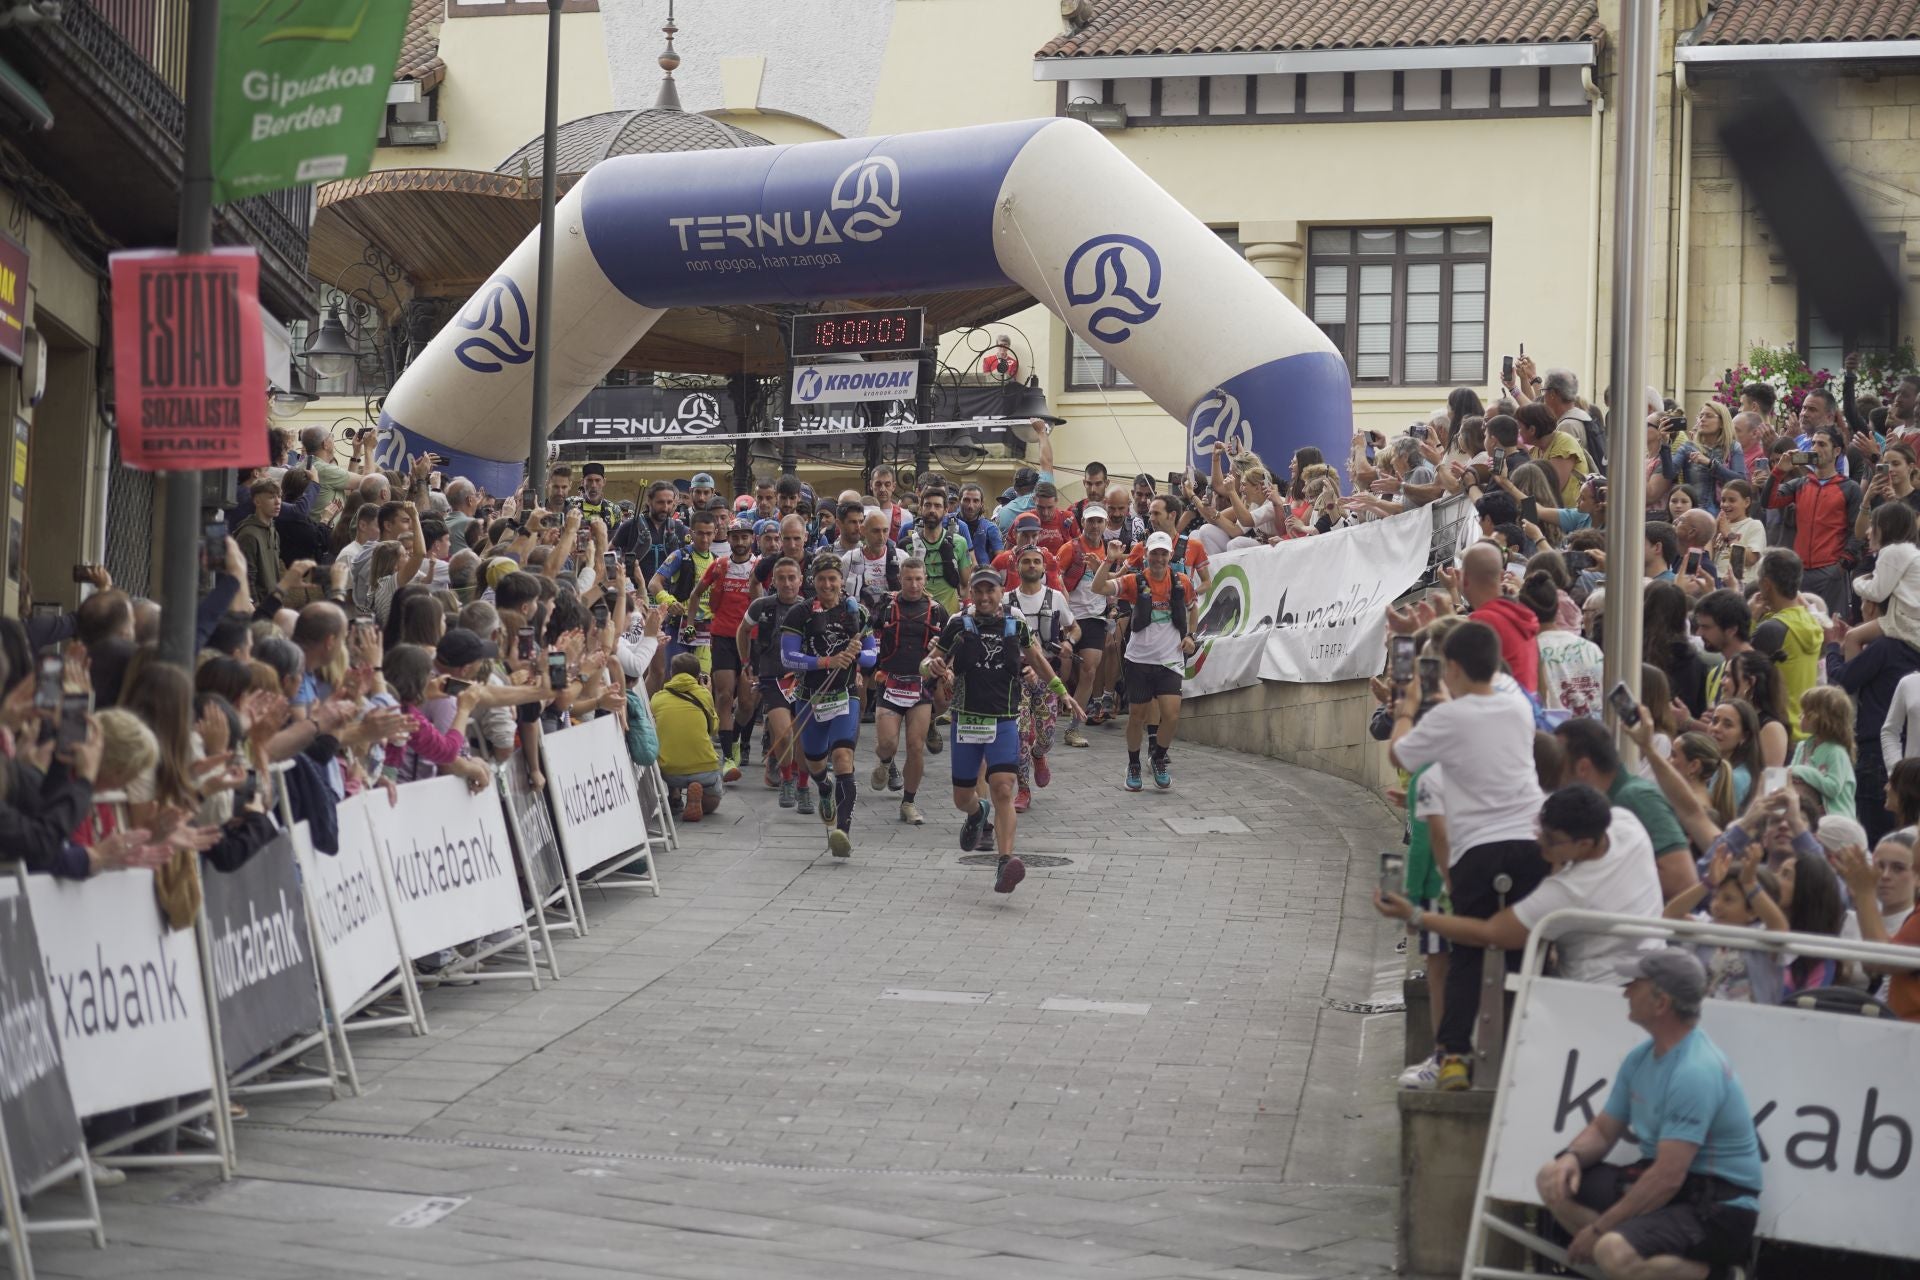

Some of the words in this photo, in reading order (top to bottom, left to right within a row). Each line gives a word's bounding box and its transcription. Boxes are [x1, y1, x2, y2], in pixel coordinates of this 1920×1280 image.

[241, 63, 376, 107] Gipuzkoa
[251, 103, 344, 142] Berdea
[669, 209, 844, 251] TERNUA
[686, 258, 711, 272] non
[715, 256, 762, 273] gogoa,
[762, 253, 790, 269] han
[791, 252, 842, 269] zangoa
[140, 271, 242, 388] ESTATU
[816, 317, 906, 346] 18:00:03
[825, 370, 914, 391] KRONOAK
[863, 388, 909, 398] kronoak.com
[142, 397, 241, 430] SOZIALISTA
[577, 417, 682, 435] TERNUA
[966, 716, 985, 726] 517
[557, 755, 632, 828] kutxabank
[385, 817, 502, 905] kutxabank
